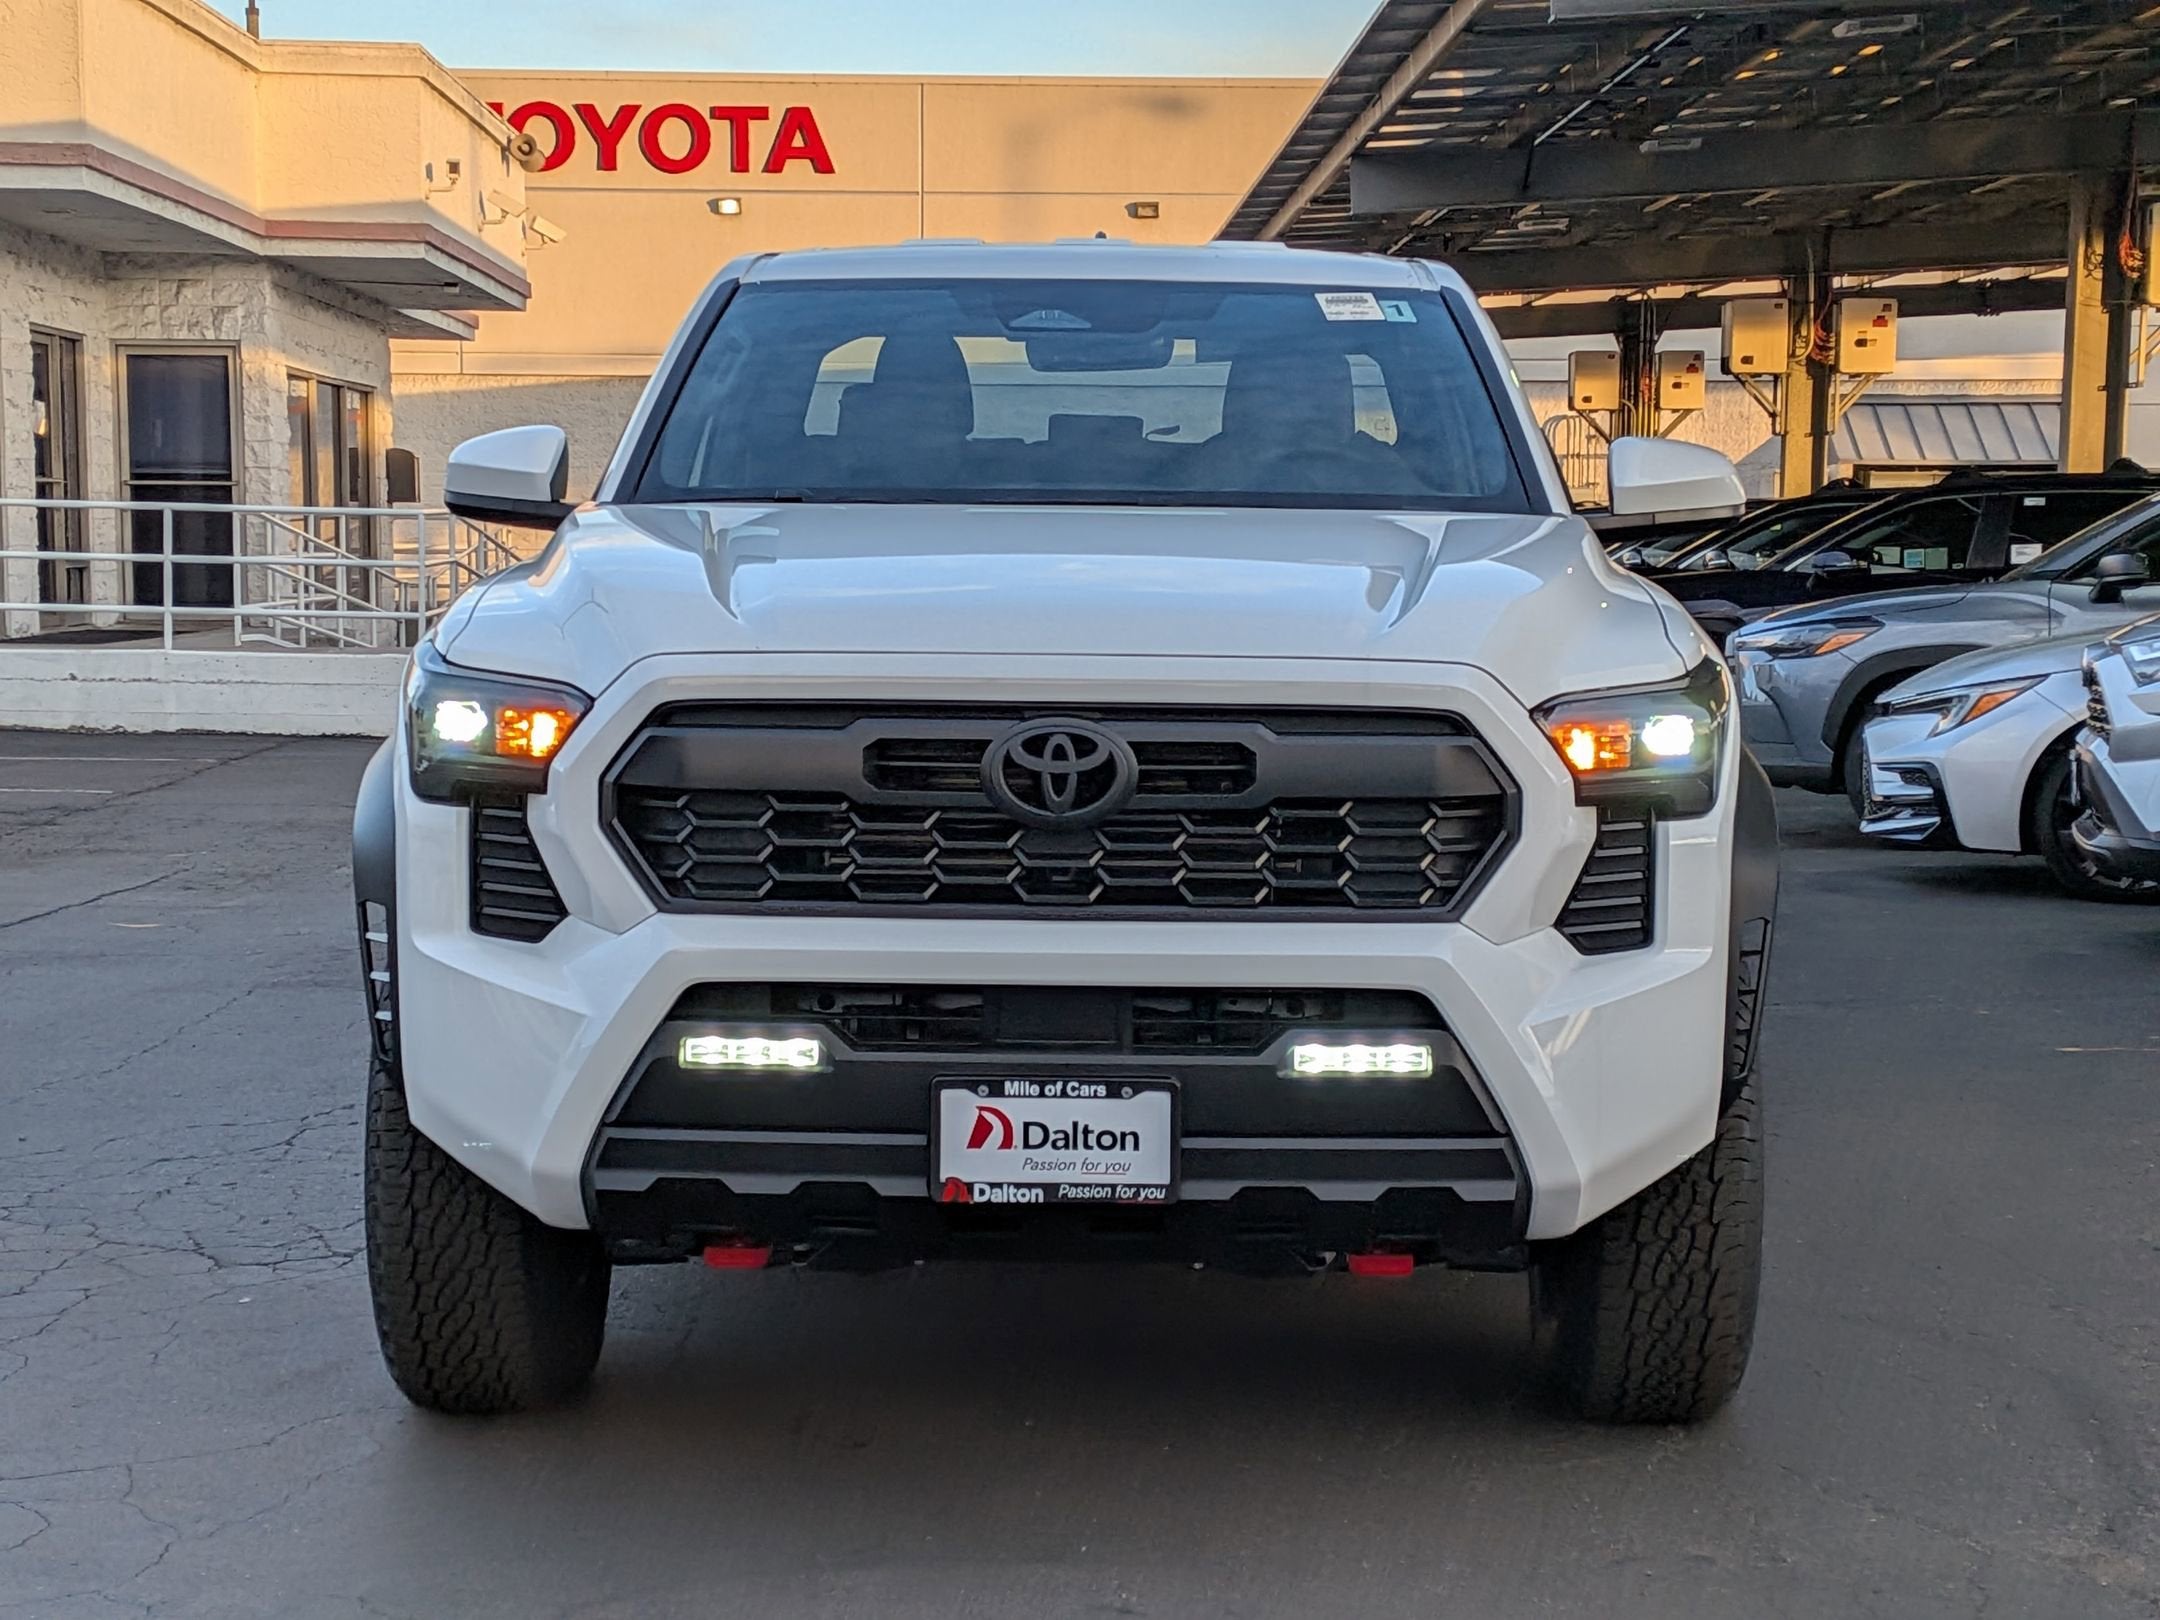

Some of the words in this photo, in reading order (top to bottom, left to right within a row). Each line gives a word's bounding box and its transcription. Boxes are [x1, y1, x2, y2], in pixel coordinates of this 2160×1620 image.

[486, 101, 836, 174] OYOTA
[1004, 1081, 1039, 1097] Mile
[1044, 1081, 1062, 1097] of
[1066, 1082, 1107, 1097] Cars
[1022, 1120, 1140, 1152] Dalton
[1022, 1157, 1076, 1172] Passion
[1081, 1157, 1103, 1173] for
[1104, 1161, 1132, 1174] you
[973, 1183, 1044, 1203] Dalton
[1058, 1183, 1112, 1199] Passion
[1115, 1184, 1137, 1199] for
[1139, 1187, 1166, 1201] you
